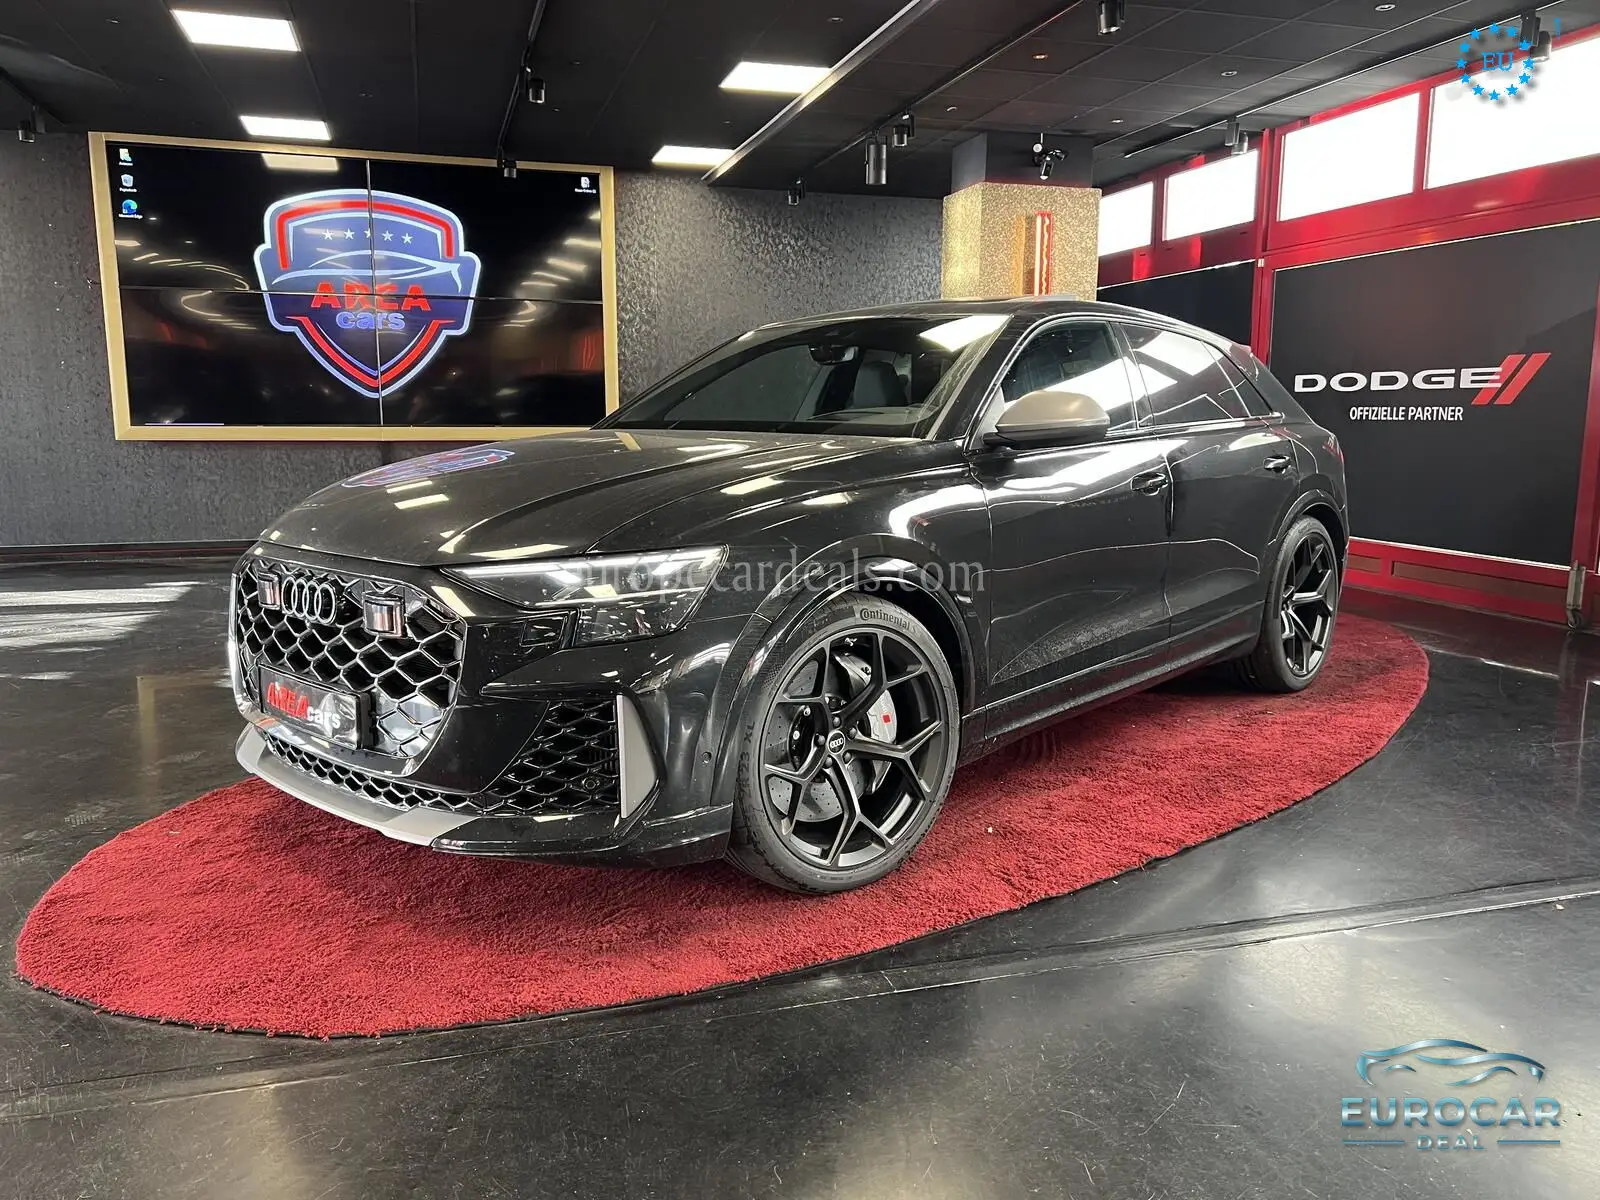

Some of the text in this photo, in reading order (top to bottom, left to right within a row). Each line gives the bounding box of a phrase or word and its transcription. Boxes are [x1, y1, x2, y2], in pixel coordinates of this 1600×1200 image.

[311, 281, 432, 311] AREA
[335, 311, 406, 330] cars
[1294, 366, 1503, 393] DODGE
[1349, 406, 1464, 421] OFFIZIELLE PARTNER
[860, 608, 911, 631] Continental
[267, 682, 341, 729] AREA cars
